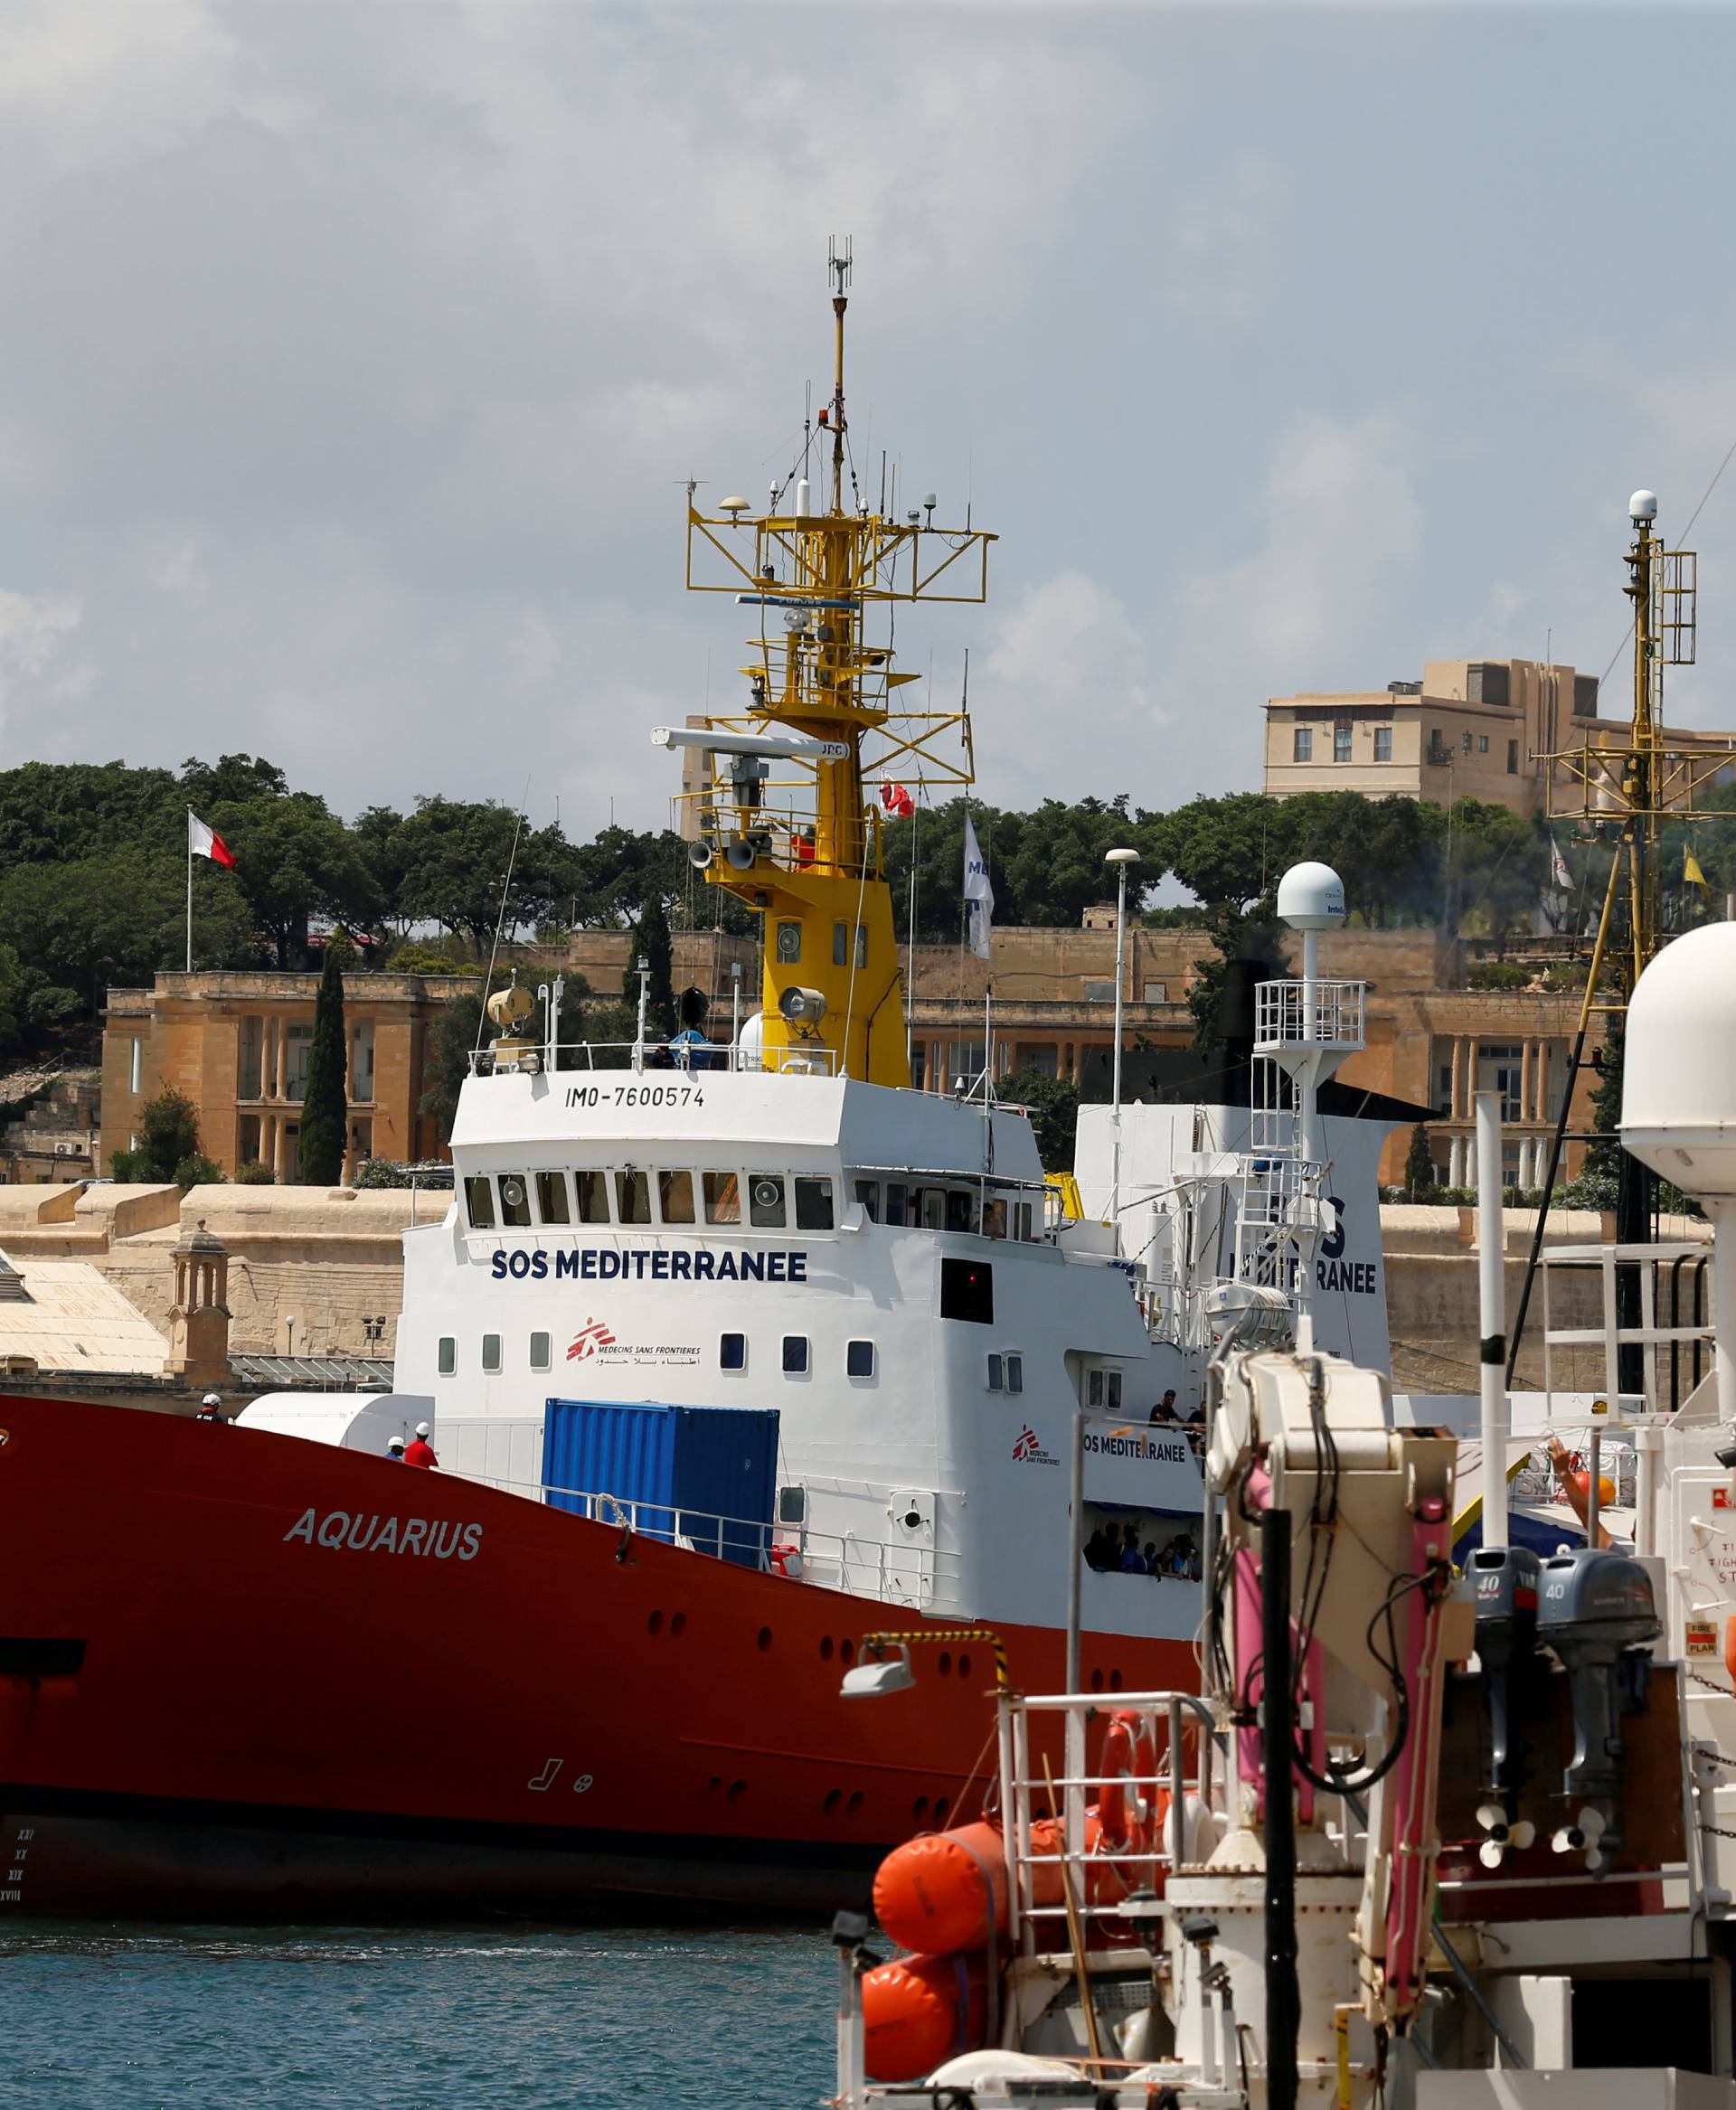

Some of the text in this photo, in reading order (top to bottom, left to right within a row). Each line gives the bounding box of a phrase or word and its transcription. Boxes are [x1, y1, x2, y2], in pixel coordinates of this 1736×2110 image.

[565, 1087, 704, 1107] IMO-7600574
[491, 1249, 807, 1282] SOS MEDITERRANEE
[598, 1344, 702, 1355] MEDECINS SANS FRONTIERES
[283, 1508, 483, 1560] AQUARIUS
[1478, 1576, 1500, 1593] 40
[1545, 1584, 1564, 1599] 40
[1692, 1625, 1712, 1634] FIRE
[1690, 1644, 1715, 1653] PLAN
[14, 1849, 28, 1860] XX
[8, 1869, 24, 1880] XIX
